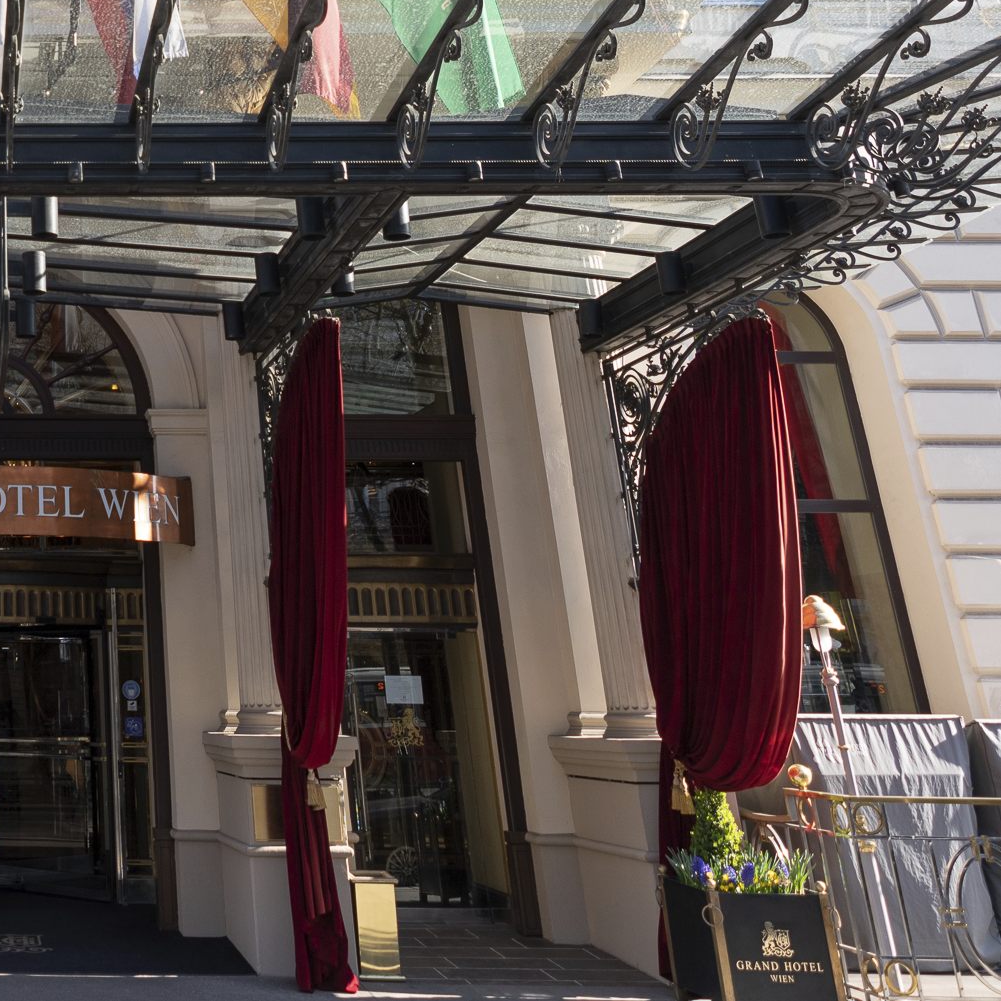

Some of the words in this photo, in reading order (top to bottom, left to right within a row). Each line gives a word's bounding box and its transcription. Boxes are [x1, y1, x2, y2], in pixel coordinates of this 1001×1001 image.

[97, 487, 180, 525] WIEN
[736, 960, 779, 971] GRAND
[784, 961, 824, 972] HOTEL
[770, 974, 795, 983] WIEN
